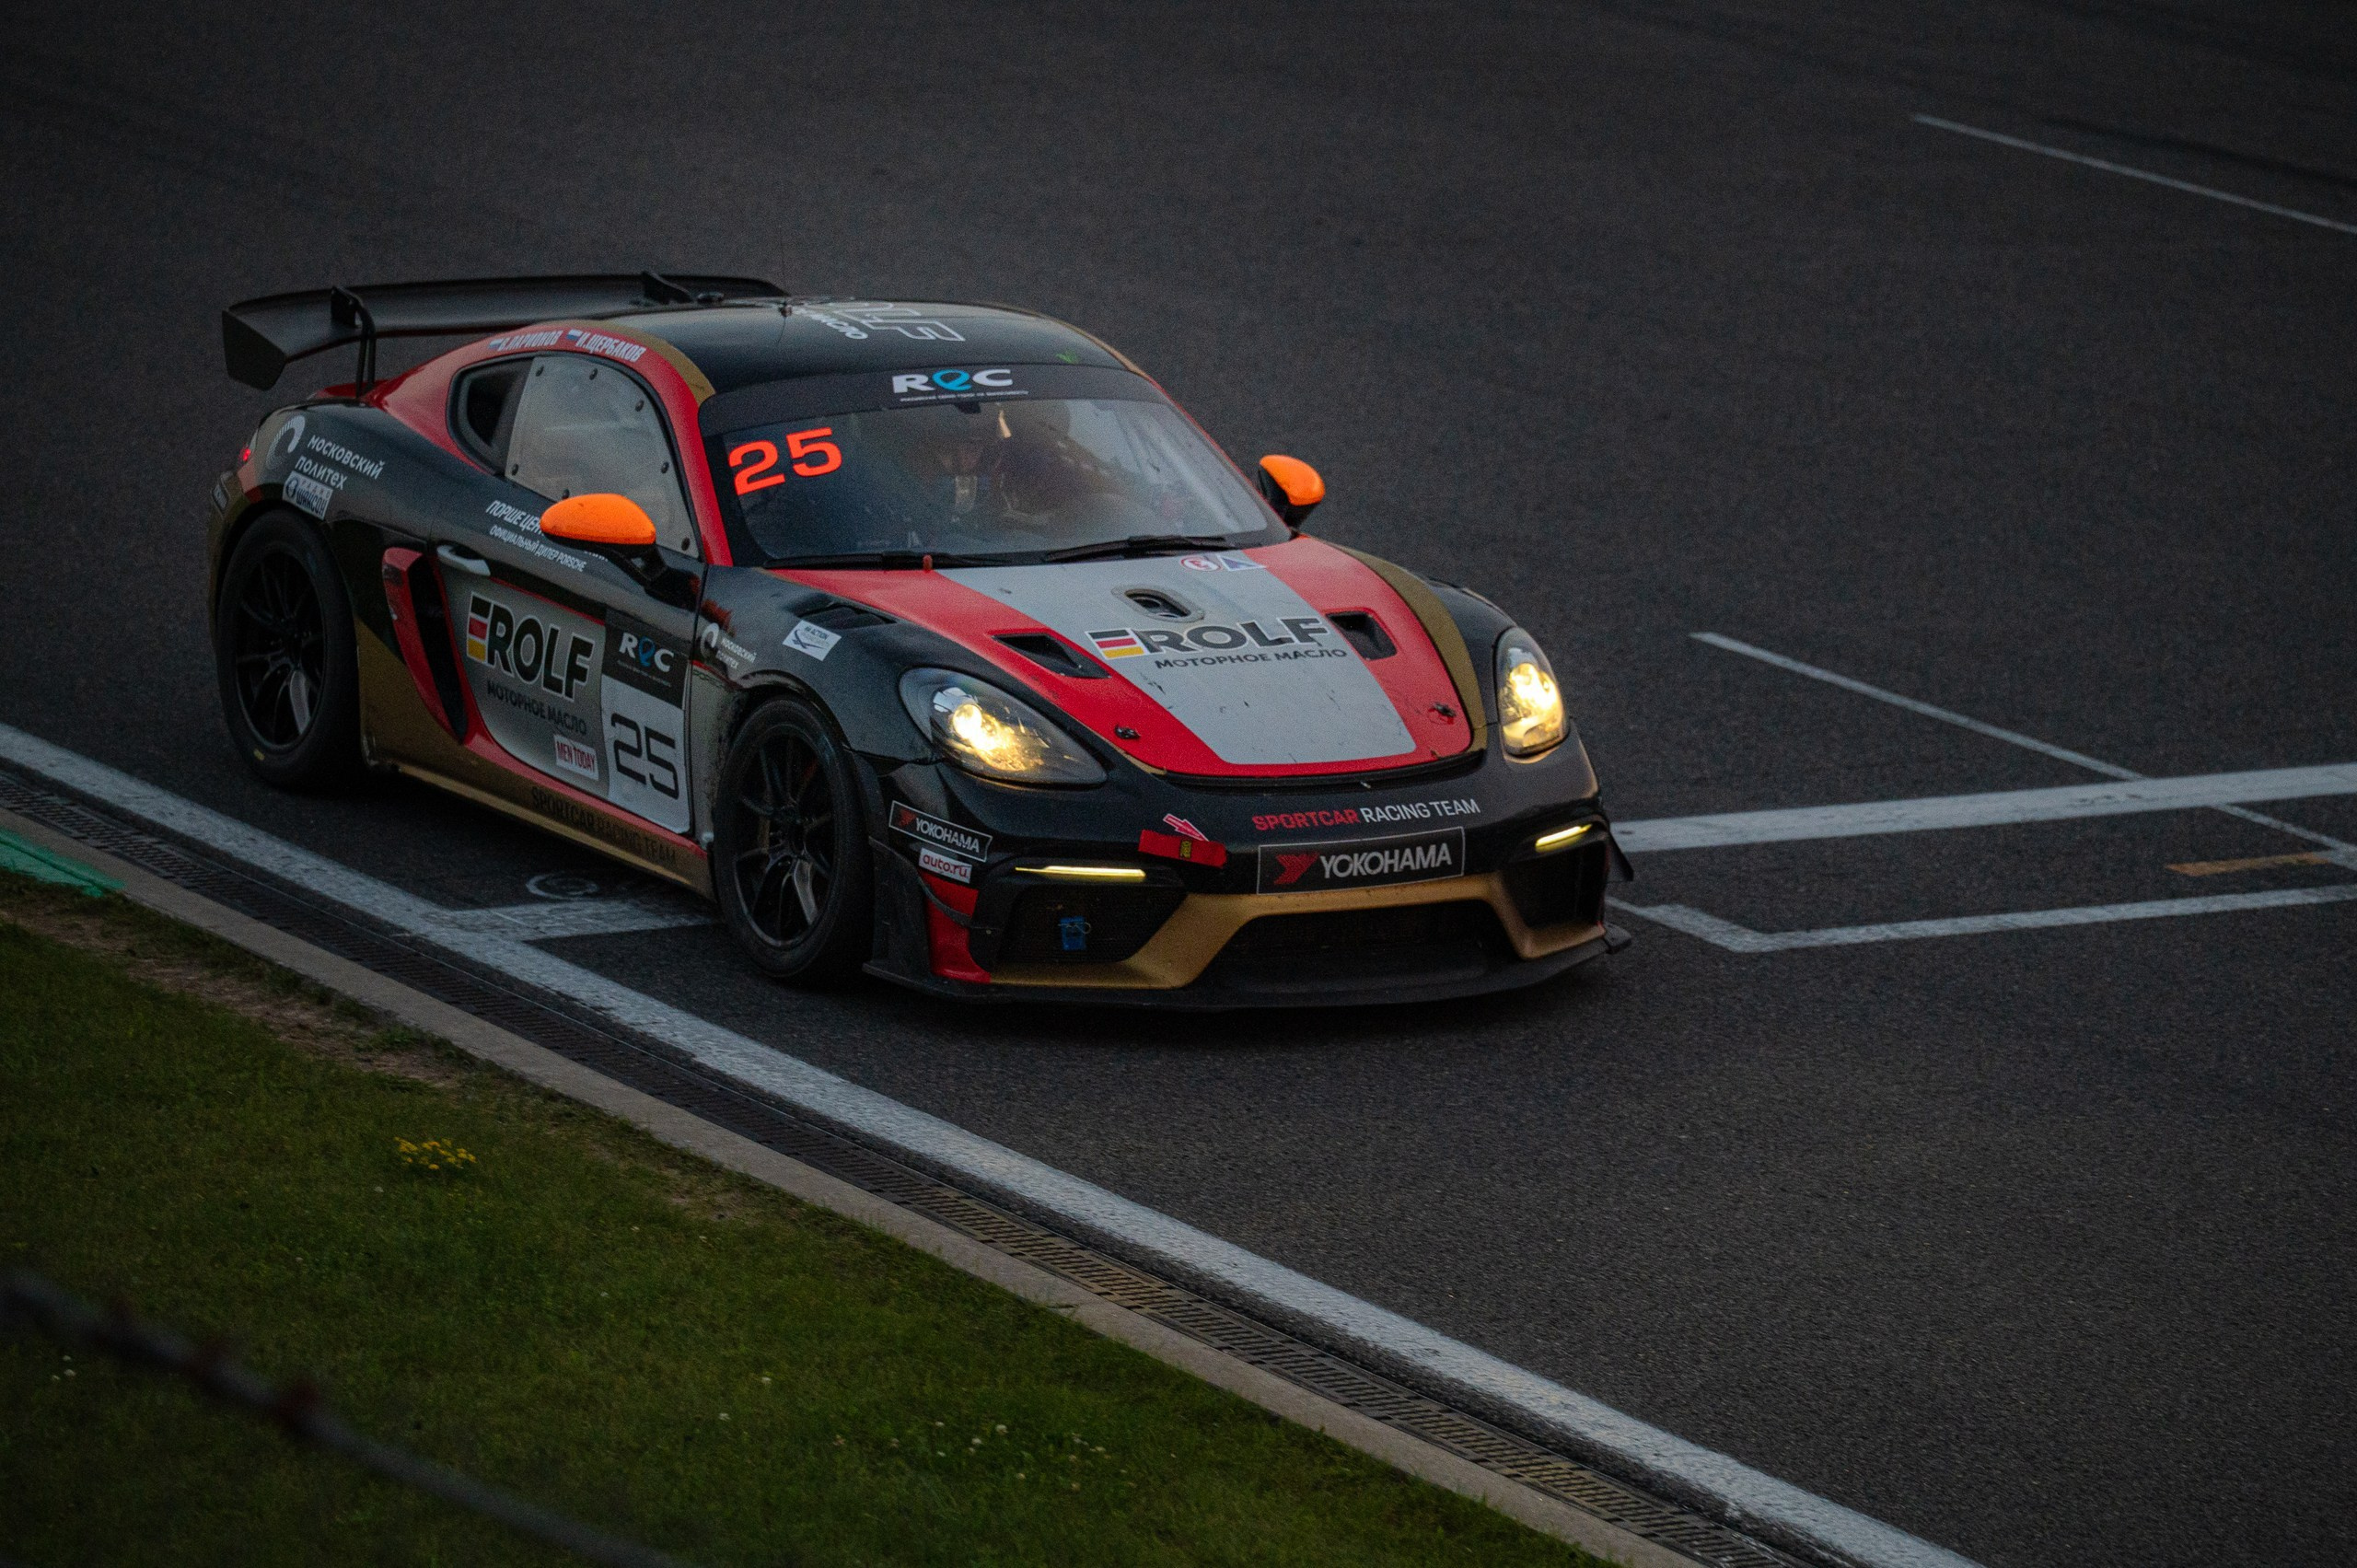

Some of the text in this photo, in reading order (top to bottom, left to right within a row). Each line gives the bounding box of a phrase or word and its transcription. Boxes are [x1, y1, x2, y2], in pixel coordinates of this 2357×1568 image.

[575, 331, 647, 363] И.ЩЕРБАКОВ
[727, 426, 842, 496] 25
[485, 500, 545, 537] ПОРШЕ ЦЕН
[489, 524, 540, 553] ОФИЦИАЛЬНЫЙ
[535, 542, 560, 562] ДИЛЕР
[556, 550, 587, 573] PORSCHE
[487, 602, 596, 703] ROLF
[1132, 617, 1329, 654] ROLF
[1155, 648, 1348, 669] МОТОРНОЕ МАСЛО
[487, 679, 587, 736] МОТОРНОЕ МАСЛО
[556, 740, 596, 772] MEN TODAY
[610, 712, 679, 800] 25
[1252, 798, 1480, 831] SPORTCAR RACING TEAM
[915, 817, 980, 854] YOKOHAMA
[923, 854, 968, 878] auto.ru
[1319, 842, 1452, 879] YOKOHAMA
